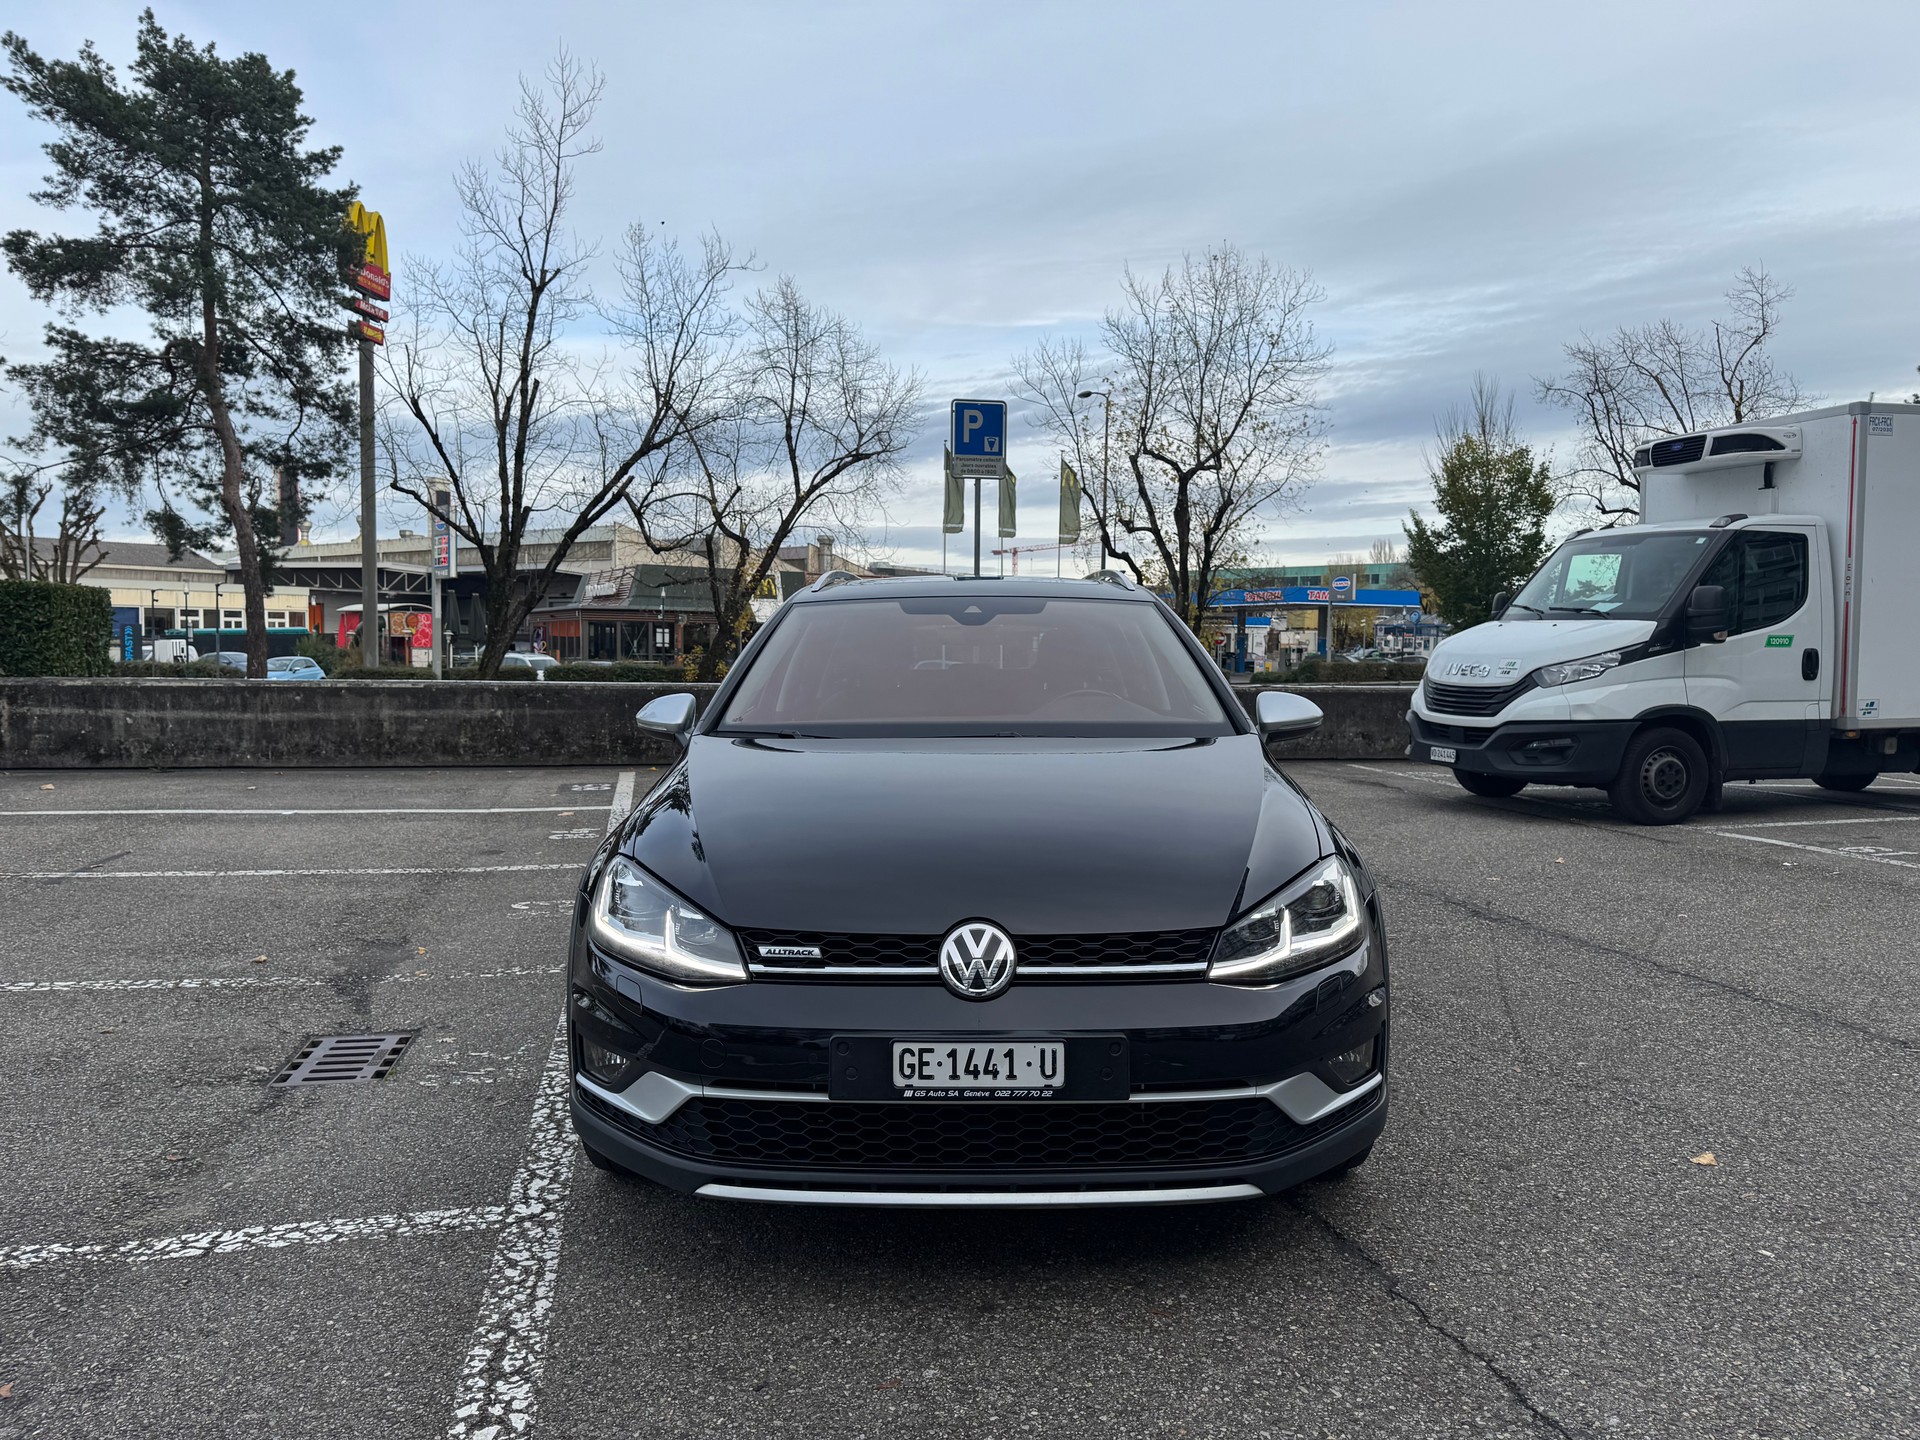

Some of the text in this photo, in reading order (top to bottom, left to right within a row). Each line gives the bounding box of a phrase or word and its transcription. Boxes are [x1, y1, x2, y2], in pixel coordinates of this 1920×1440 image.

[963, 409, 984, 443] P
[1446, 662, 1491, 678] IVECO
[765, 948, 815, 956] ALLTRACK
